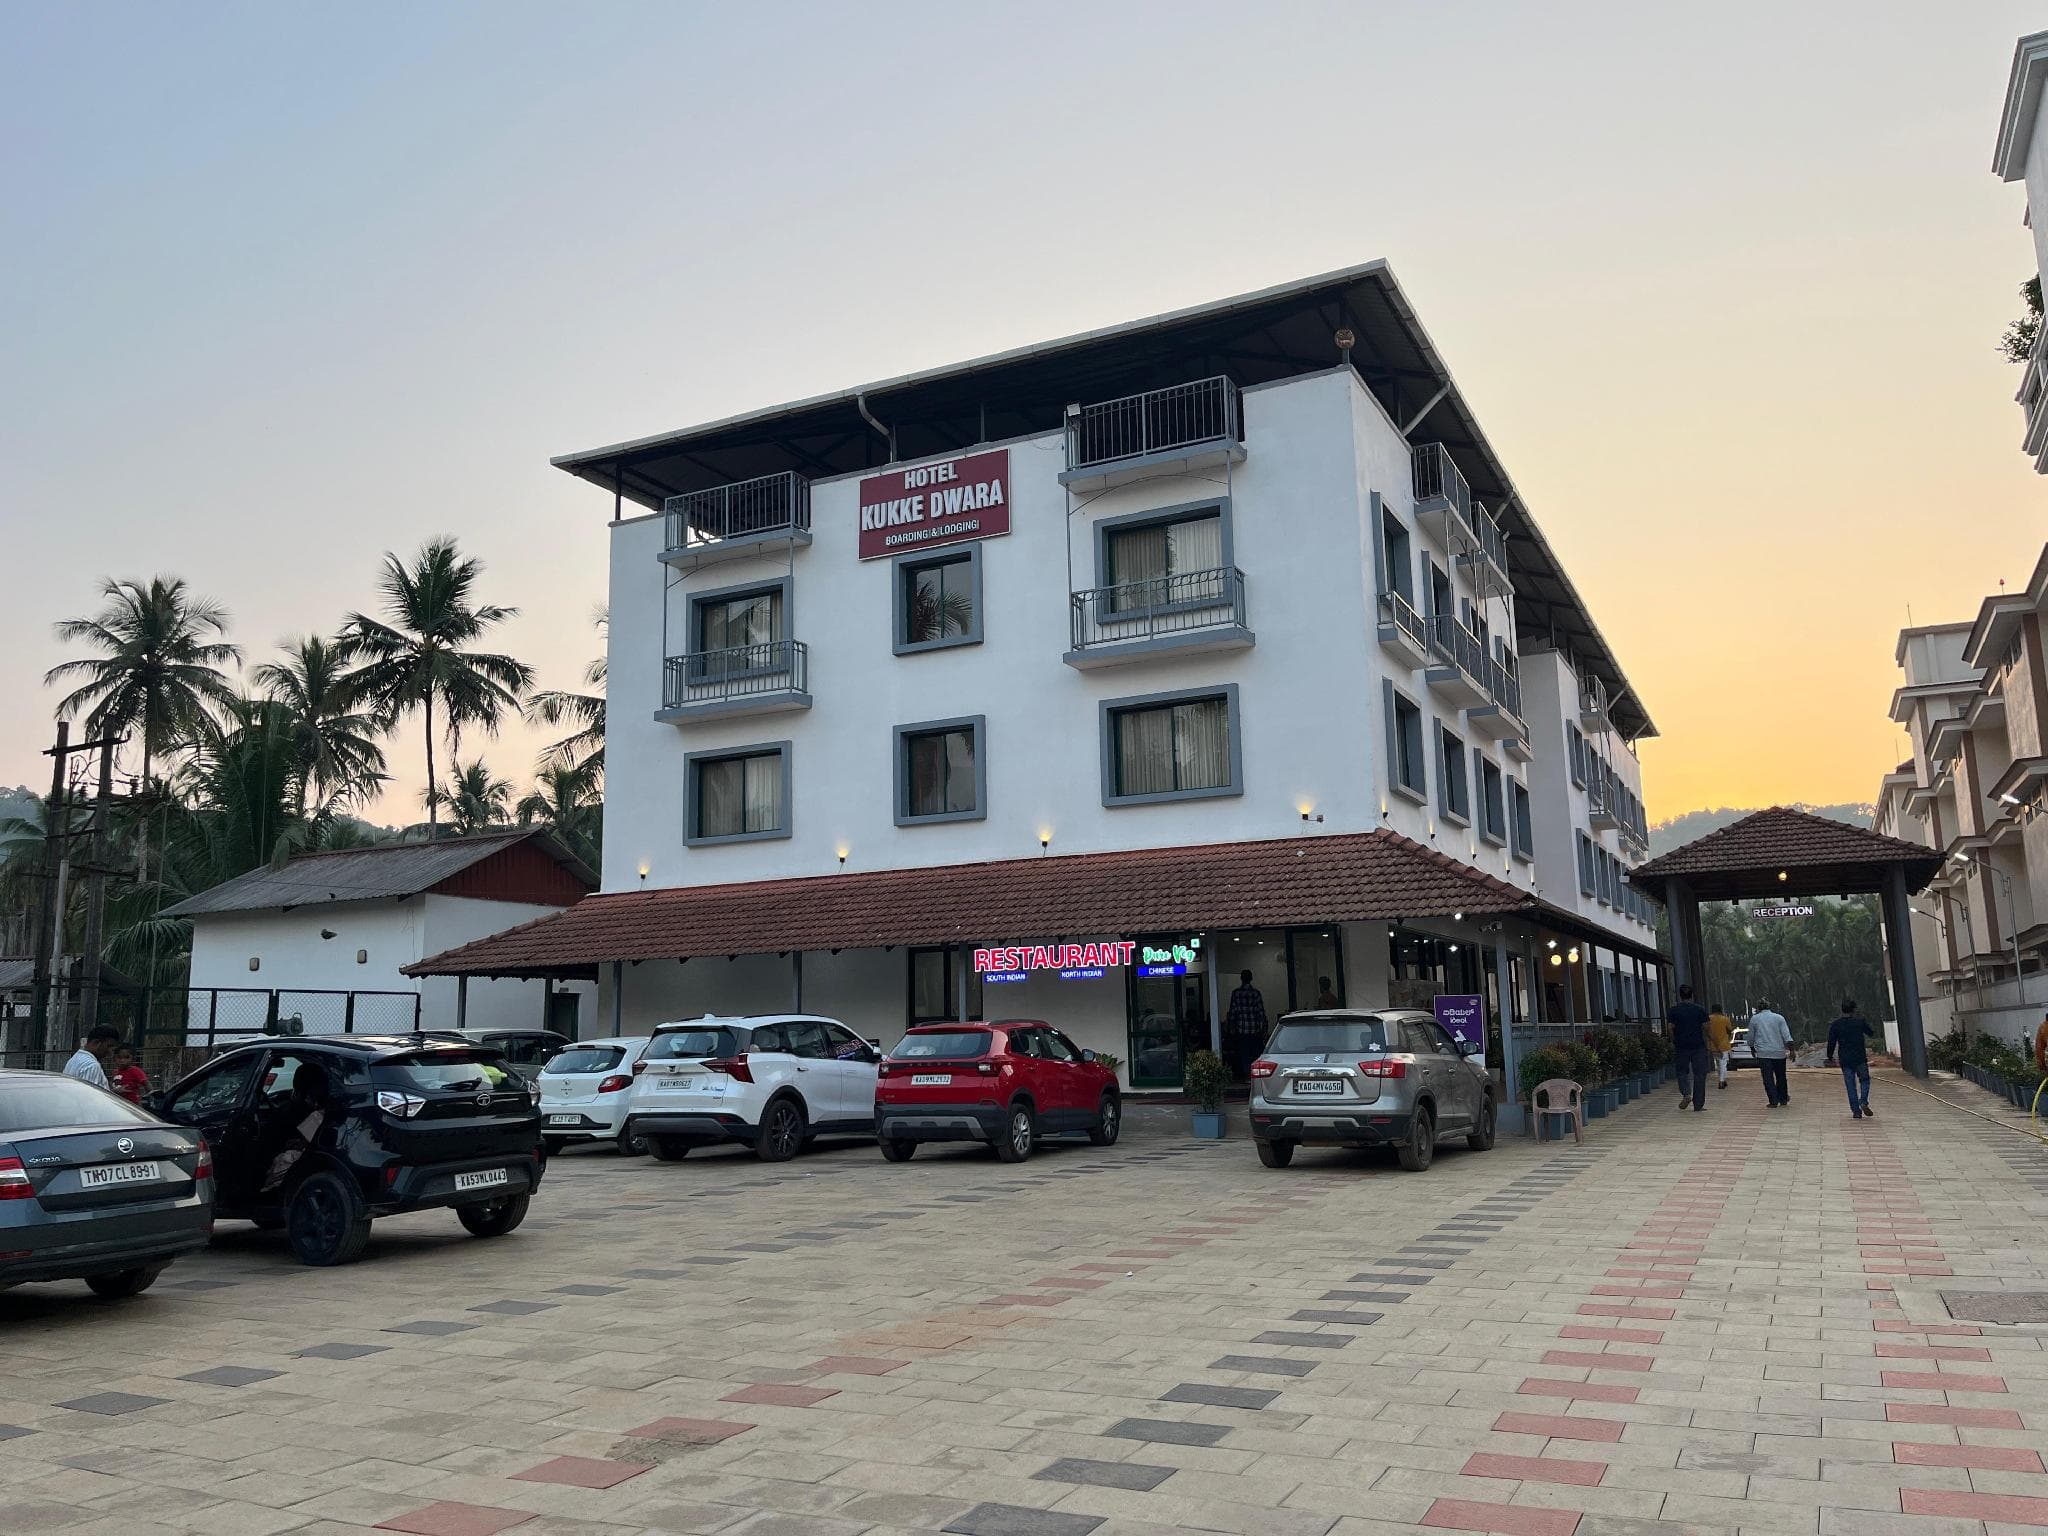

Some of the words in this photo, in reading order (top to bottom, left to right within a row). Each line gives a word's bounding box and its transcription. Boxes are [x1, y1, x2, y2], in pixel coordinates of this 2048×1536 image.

[904, 462, 958, 490] HOTEL
[861, 495, 925, 531] KUKKE
[930, 479, 1004, 518] DWARA
[885, 529, 929, 546] BOARDING
[931, 528, 938, 537] &
[940, 519, 979, 535] LODGING
[1753, 906, 1813, 917] RECEPTION
[974, 941, 1136, 972] RESTAURANT
[1143, 946, 1171, 964] Pure
[1172, 945, 1196, 963] Veg
[986, 974, 1005, 982] SOUTH
[1006, 973, 1026, 981] INDIAN
[1081, 970, 1102, 978] INDIAN
[1148, 966, 1174, 975] CHINESE
[1299, 1082, 1341, 1091] KA04MV4650
[461, 1170, 506, 1187] KA53ML0443
